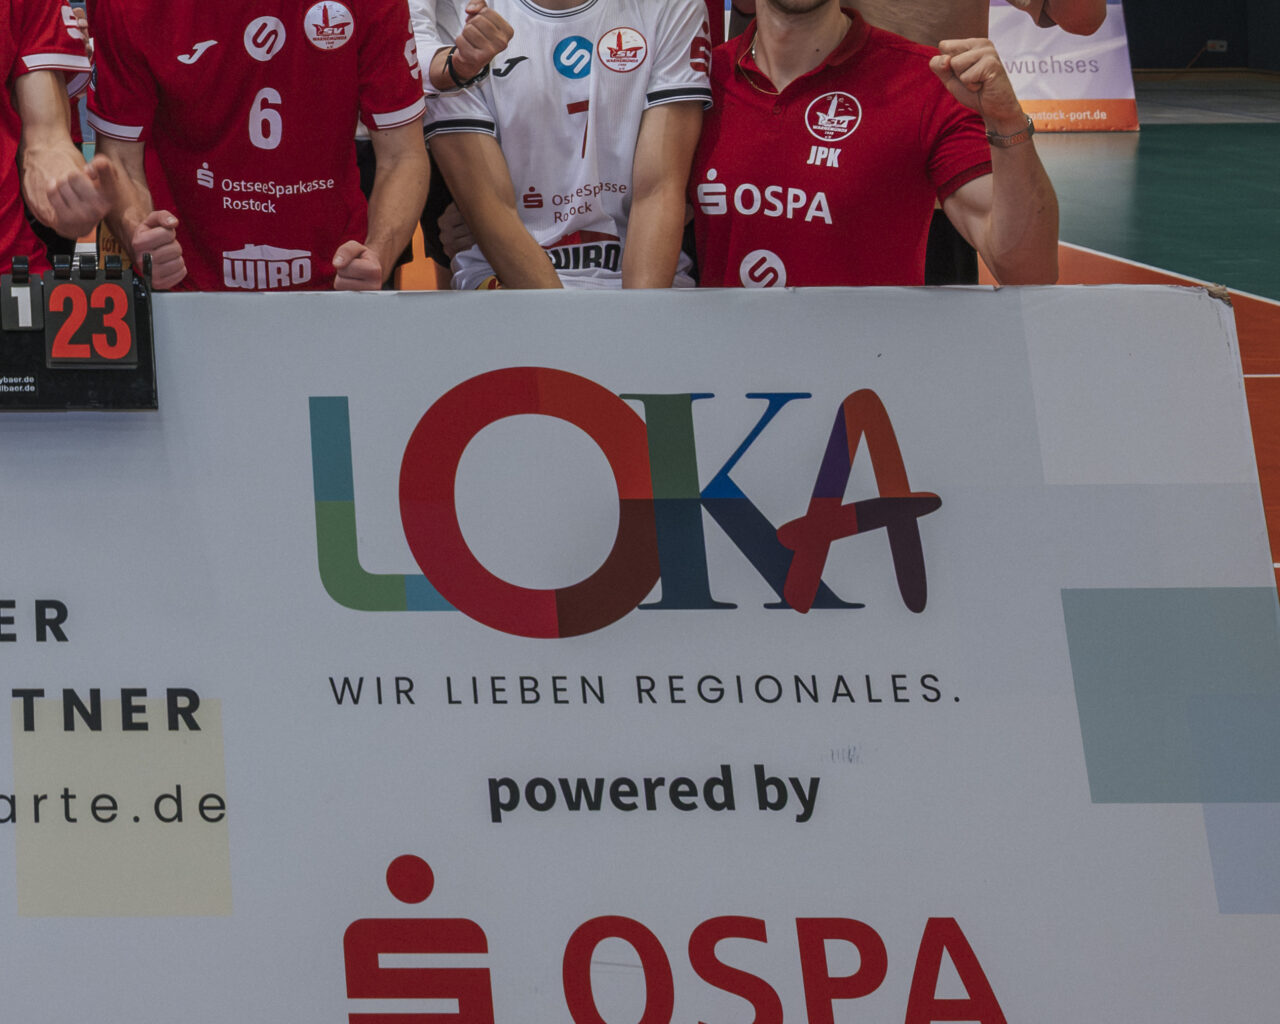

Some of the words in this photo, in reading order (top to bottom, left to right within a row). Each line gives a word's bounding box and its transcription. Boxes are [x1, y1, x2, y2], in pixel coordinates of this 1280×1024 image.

[248, 87, 283, 150] 6
[806, 145, 842, 168] JPK
[221, 179, 335, 198] OstseeSparkasse
[223, 197, 277, 213] Rostock
[733, 183, 833, 225] OSPA
[222, 257, 312, 290] WIRO
[10, 286, 33, 327] 1
[48, 283, 132, 360] 23
[308, 366, 943, 639] LOKA
[329, 676, 416, 706] WIR
[446, 675, 606, 705] LIEBEN
[636, 673, 961, 704] REGIONALES.
[487, 764, 736, 824] powered
[753, 764, 821, 824] by
[561, 914, 1009, 1024] OSPA
